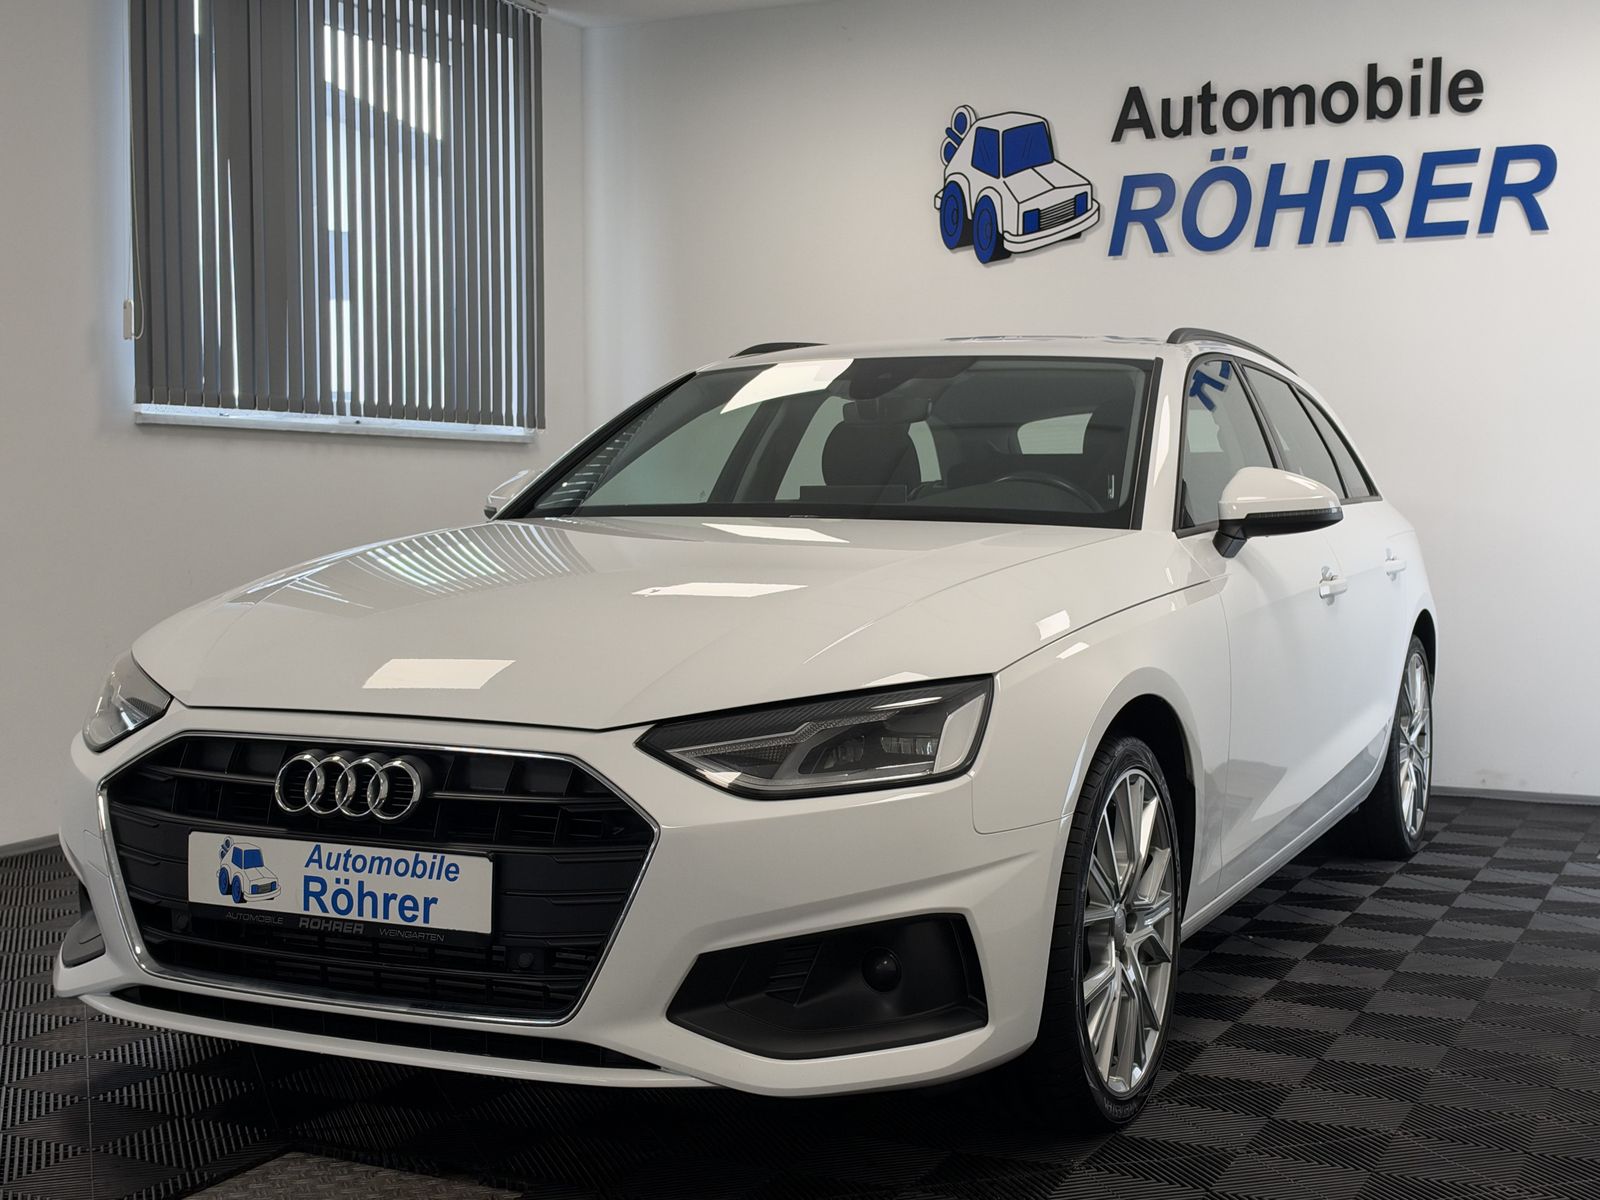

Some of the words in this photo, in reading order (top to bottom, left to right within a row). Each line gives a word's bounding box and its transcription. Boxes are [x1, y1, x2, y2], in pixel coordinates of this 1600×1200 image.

[1111, 57, 1484, 142] Automobile
[1108, 144, 1557, 257] RÖHRER
[304, 844, 460, 882] Automobile
[303, 875, 438, 924] Röhrer
[225, 911, 284, 925] AUTOMOBILE
[379, 928, 445, 943] WEINGARTEN
